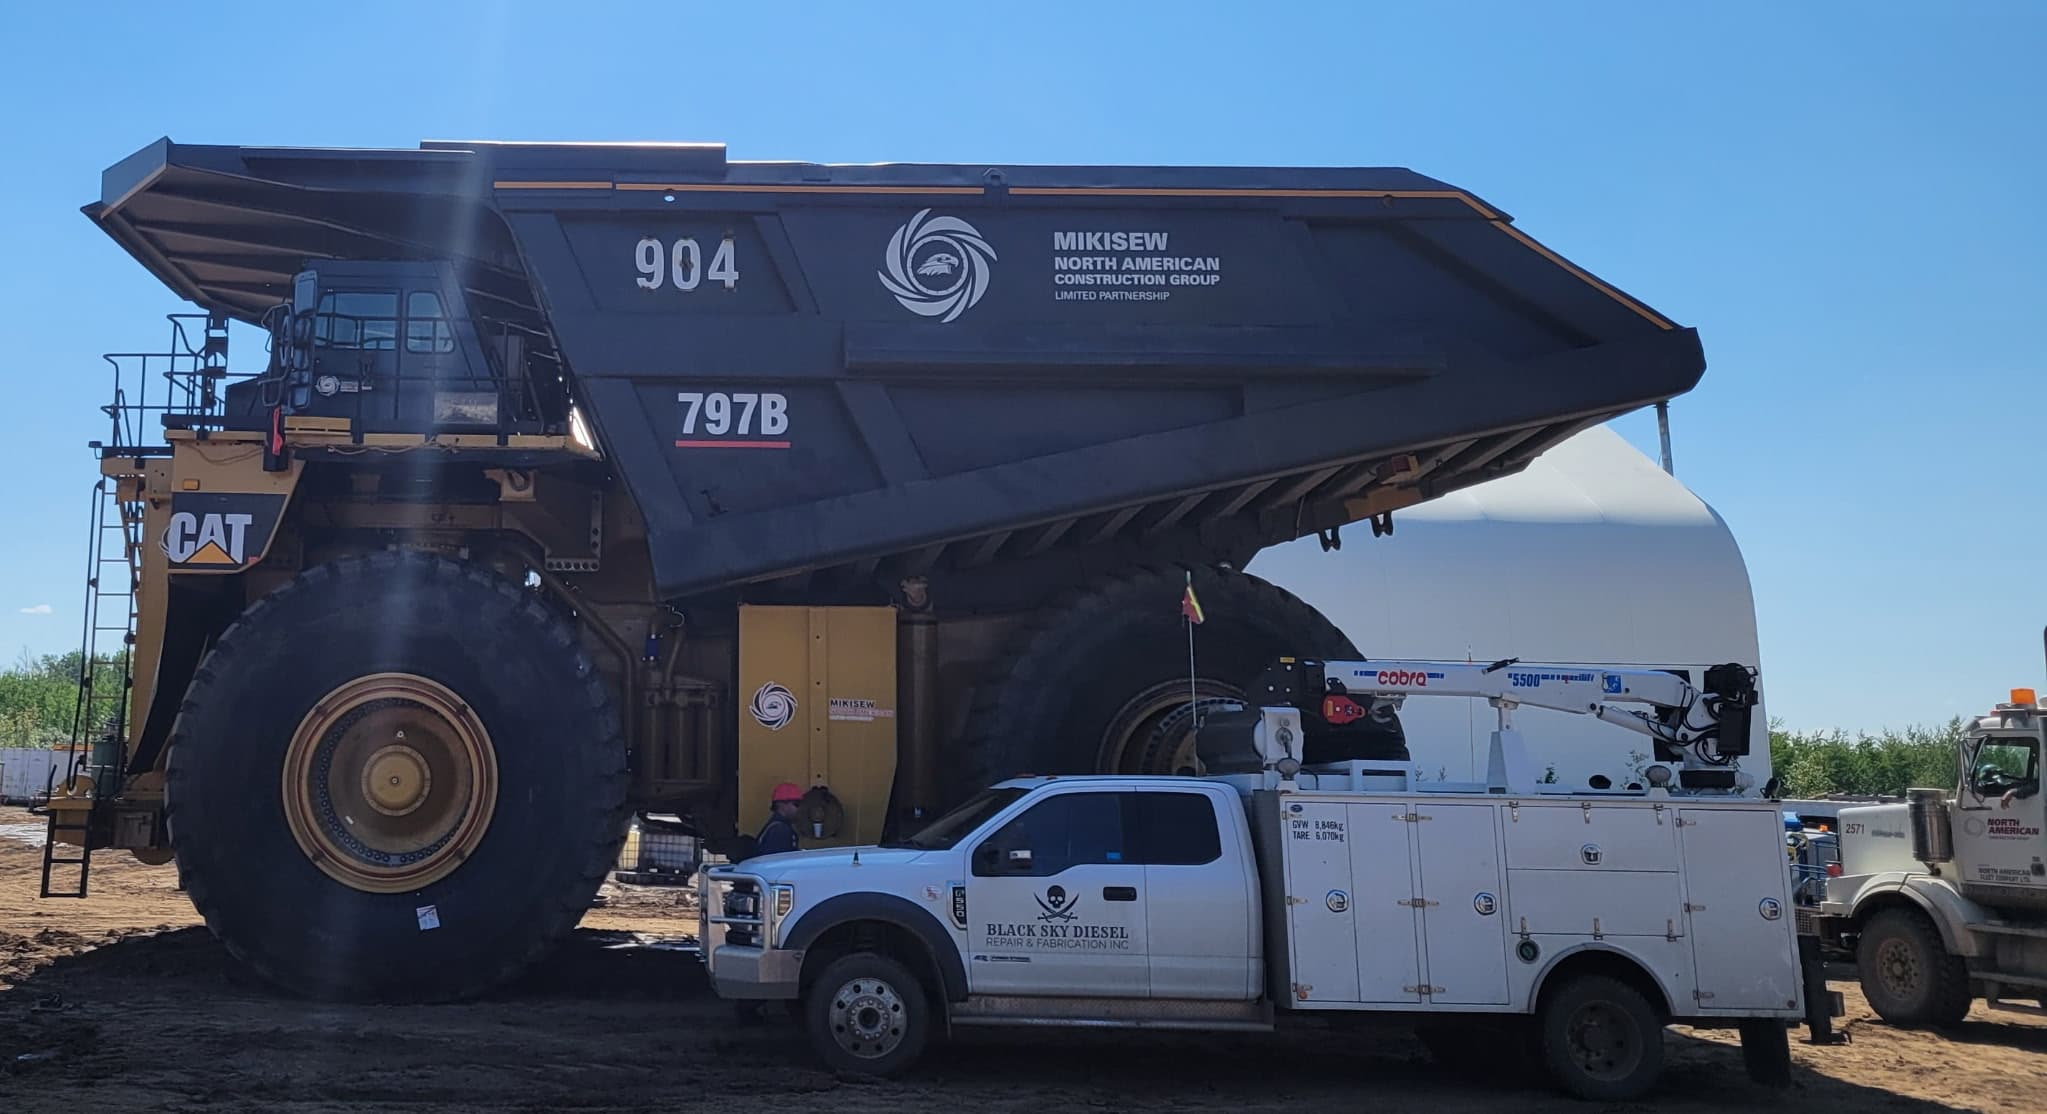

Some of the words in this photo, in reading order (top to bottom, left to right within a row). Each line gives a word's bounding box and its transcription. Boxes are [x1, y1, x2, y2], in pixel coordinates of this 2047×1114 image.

[1053, 231, 1169, 251] MIKISEW
[634, 235, 740, 291] 904
[1054, 256, 1118, 271] NORTH
[1121, 257, 1221, 271] AMERICAN
[1054, 273, 1166, 285] CONSTRUCTION
[1169, 274, 1221, 286] GROUP
[1055, 290, 1097, 301] LIMITED
[1099, 291, 1171, 301] PARTNERSHIP
[677, 392, 789, 436] 797B
[166, 511, 253, 565] CAT
[1376, 668, 1428, 688] cobra
[1512, 672, 1541, 688] 5500
[829, 699, 876, 709] MIKISEW
[1292, 819, 1309, 830] GVW
[1845, 823, 1866, 835] 2571
[1987, 818, 2020, 827] NORTH
[1292, 830, 1311, 841] TARE
[1988, 827, 2040, 836] AMERICAN
[986, 923, 1037, 937] BLACK
[1040, 925, 1070, 938] SKY
[1073, 925, 1130, 939] DIESEL
[985, 937, 1025, 948] REPAIR
[1026, 938, 1034, 948] &
[1036, 938, 1107, 950] FABRICATION
[1109, 939, 1129, 950] INC
